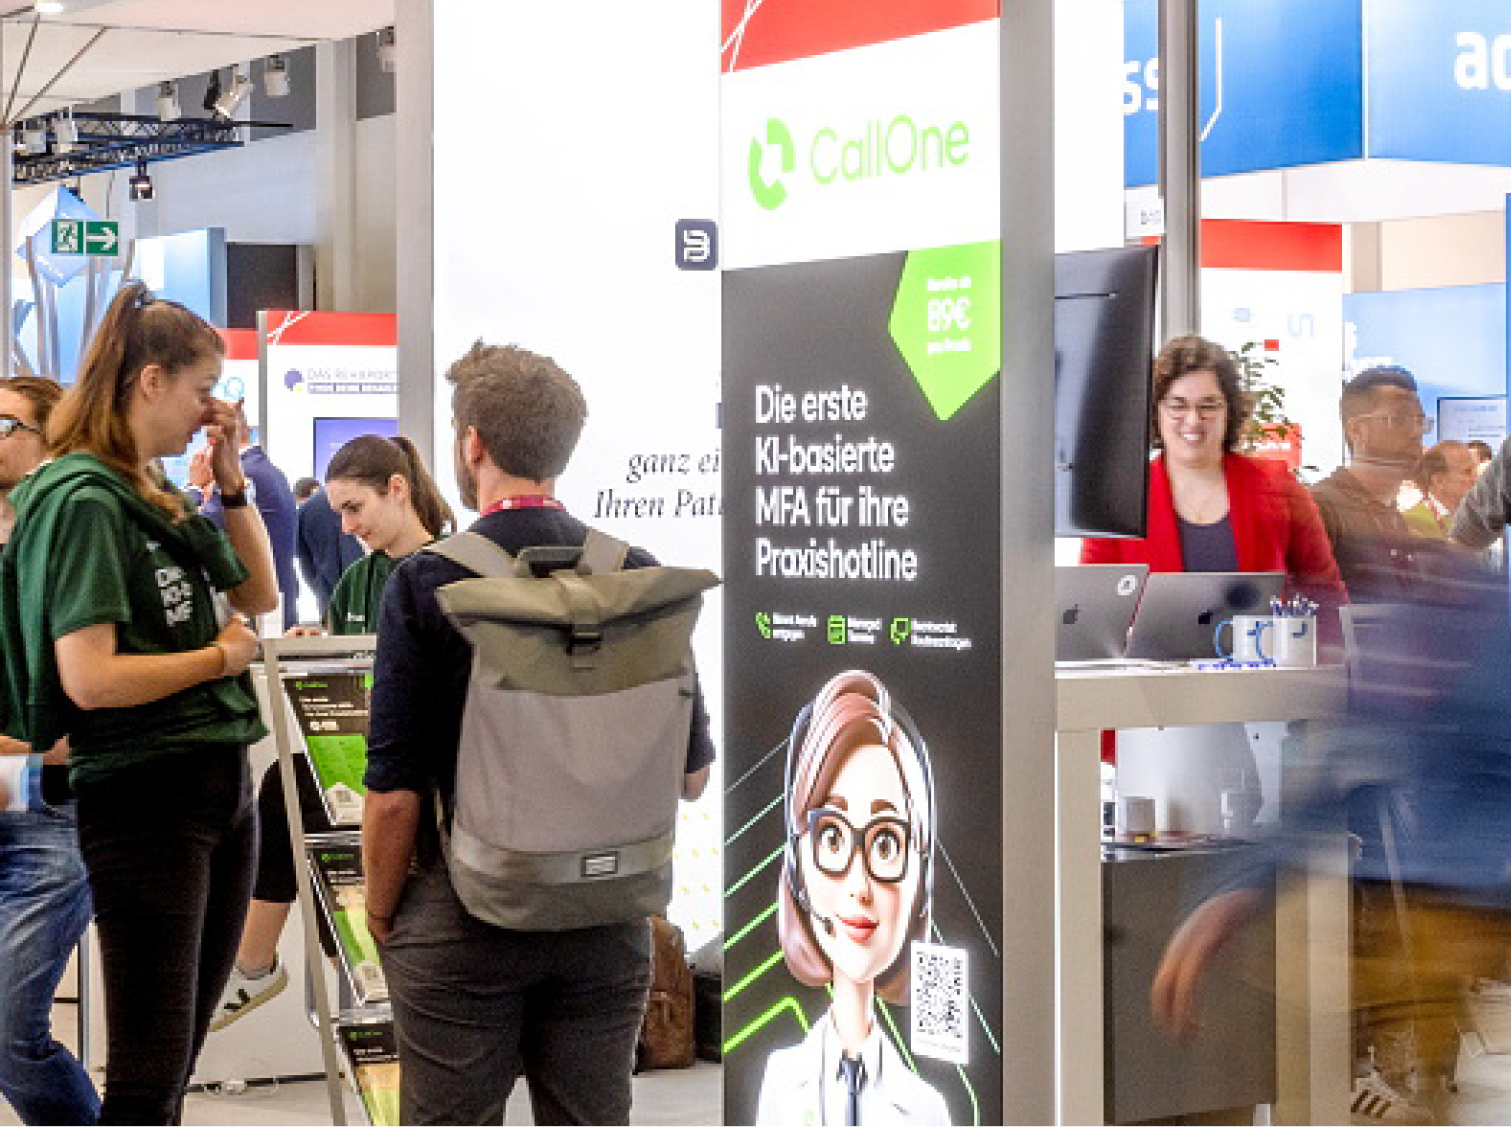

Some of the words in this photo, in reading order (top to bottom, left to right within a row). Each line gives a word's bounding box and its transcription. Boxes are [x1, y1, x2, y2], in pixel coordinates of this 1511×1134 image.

[809, 113, 971, 186] CallOne
[754, 383, 797, 425] Die
[801, 384, 868, 422] erste
[625, 452, 691, 485] ganz
[754, 434, 896, 476] KI-basierte
[593, 488, 665, 519] Ihren
[754, 486, 812, 529] MFA
[814, 486, 855, 528] für
[858, 485, 910, 529] ihre
[754, 536, 919, 582] Praxishotline
